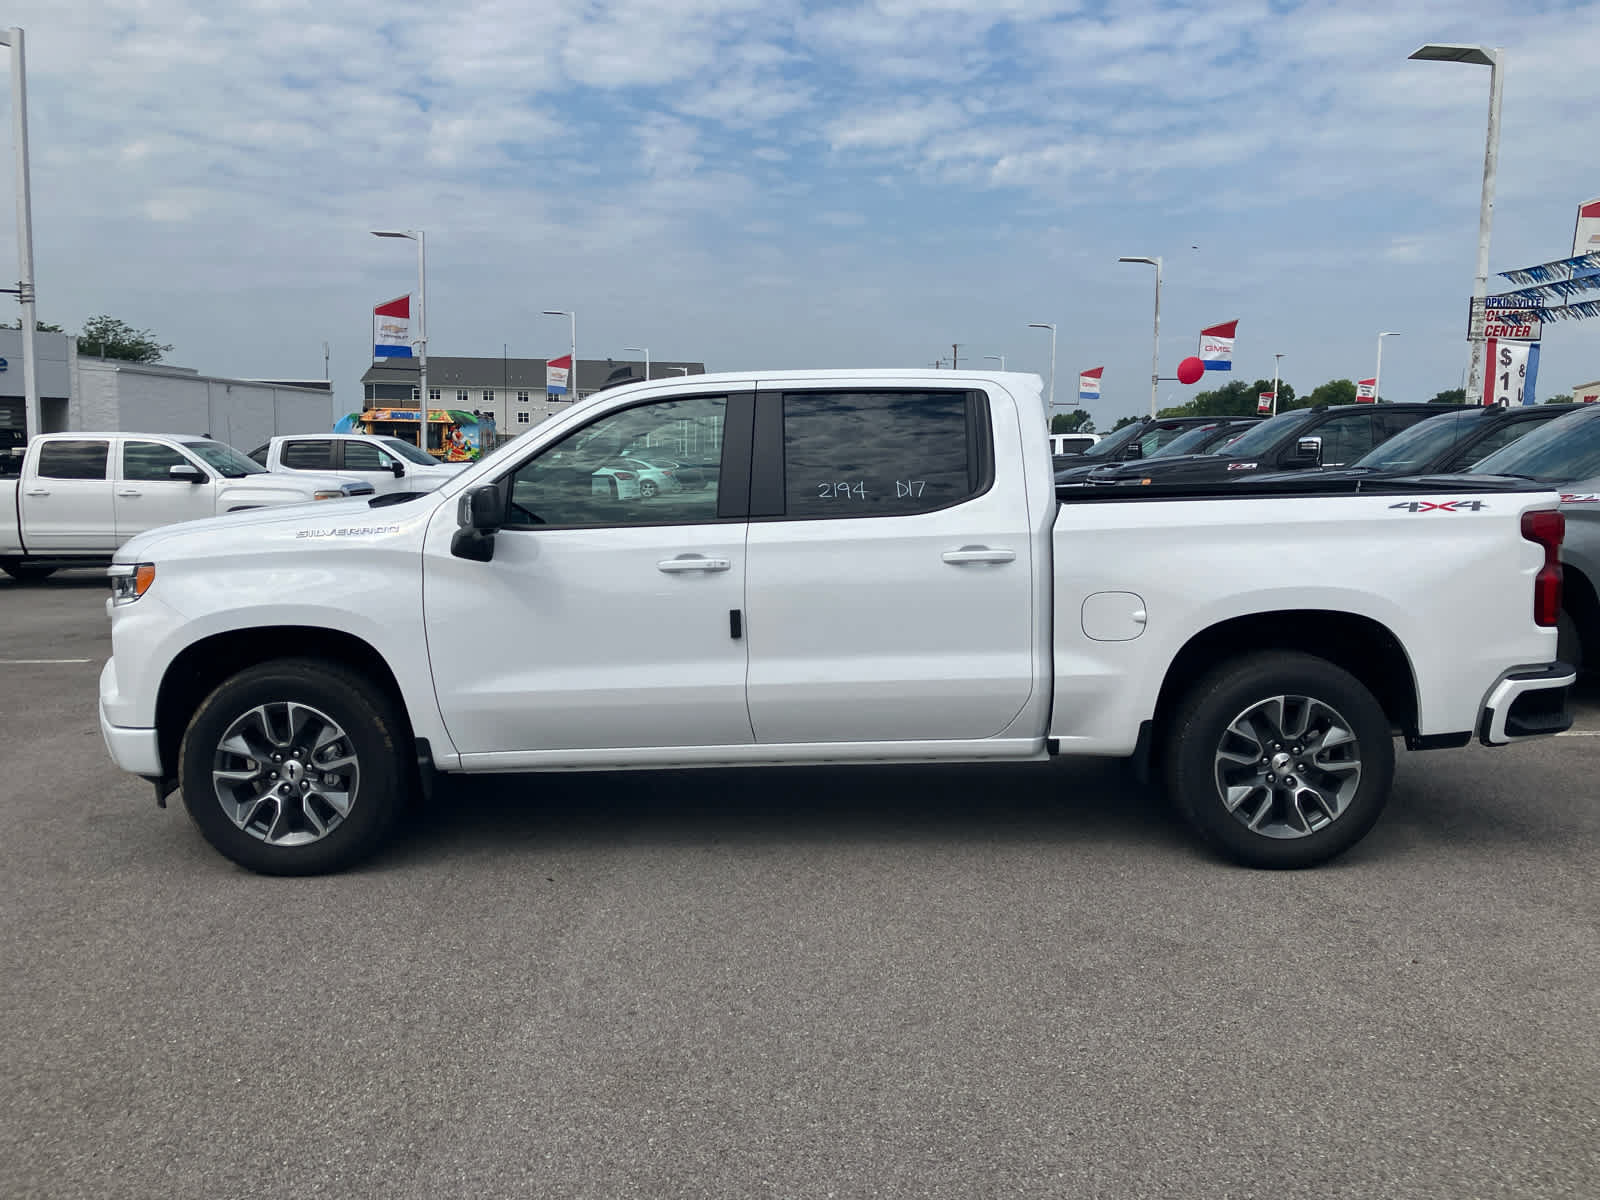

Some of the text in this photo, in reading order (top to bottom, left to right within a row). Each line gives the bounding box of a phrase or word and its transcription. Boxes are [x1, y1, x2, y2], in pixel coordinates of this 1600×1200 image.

[1484, 325, 1531, 337] CENTER
[817, 480, 870, 500] 2194
[296, 525, 400, 538] SILVERADO
